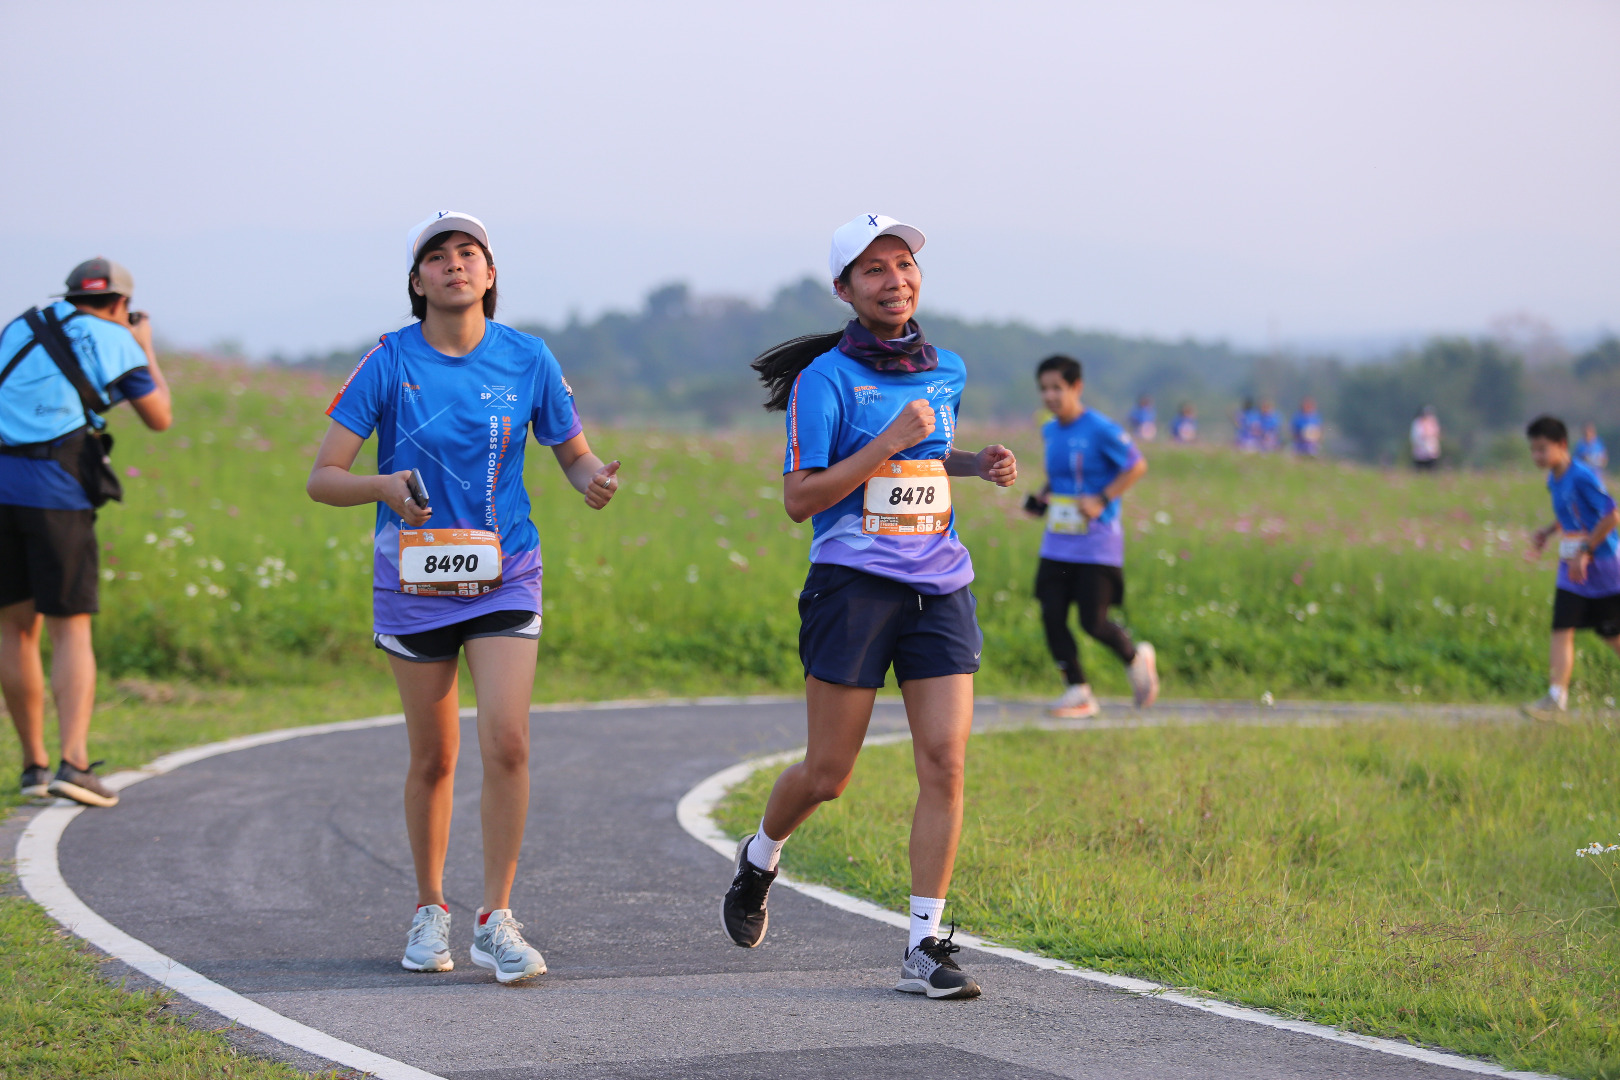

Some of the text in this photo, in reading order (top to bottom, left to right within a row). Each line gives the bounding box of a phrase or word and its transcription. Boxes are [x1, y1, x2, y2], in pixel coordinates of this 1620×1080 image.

[480, 392, 518, 402] SP XC
[926, 386, 935, 394] SP
[489, 415, 499, 450] CROSS
[498, 415, 512, 460] SINGHA
[485, 452, 497, 503] COUNTRY
[888, 485, 936, 506] 8478
[485, 504, 493, 526] RUN
[869, 518, 876, 529] F
[424, 553, 479, 574] 8490
[482, 585, 490, 593] 8
